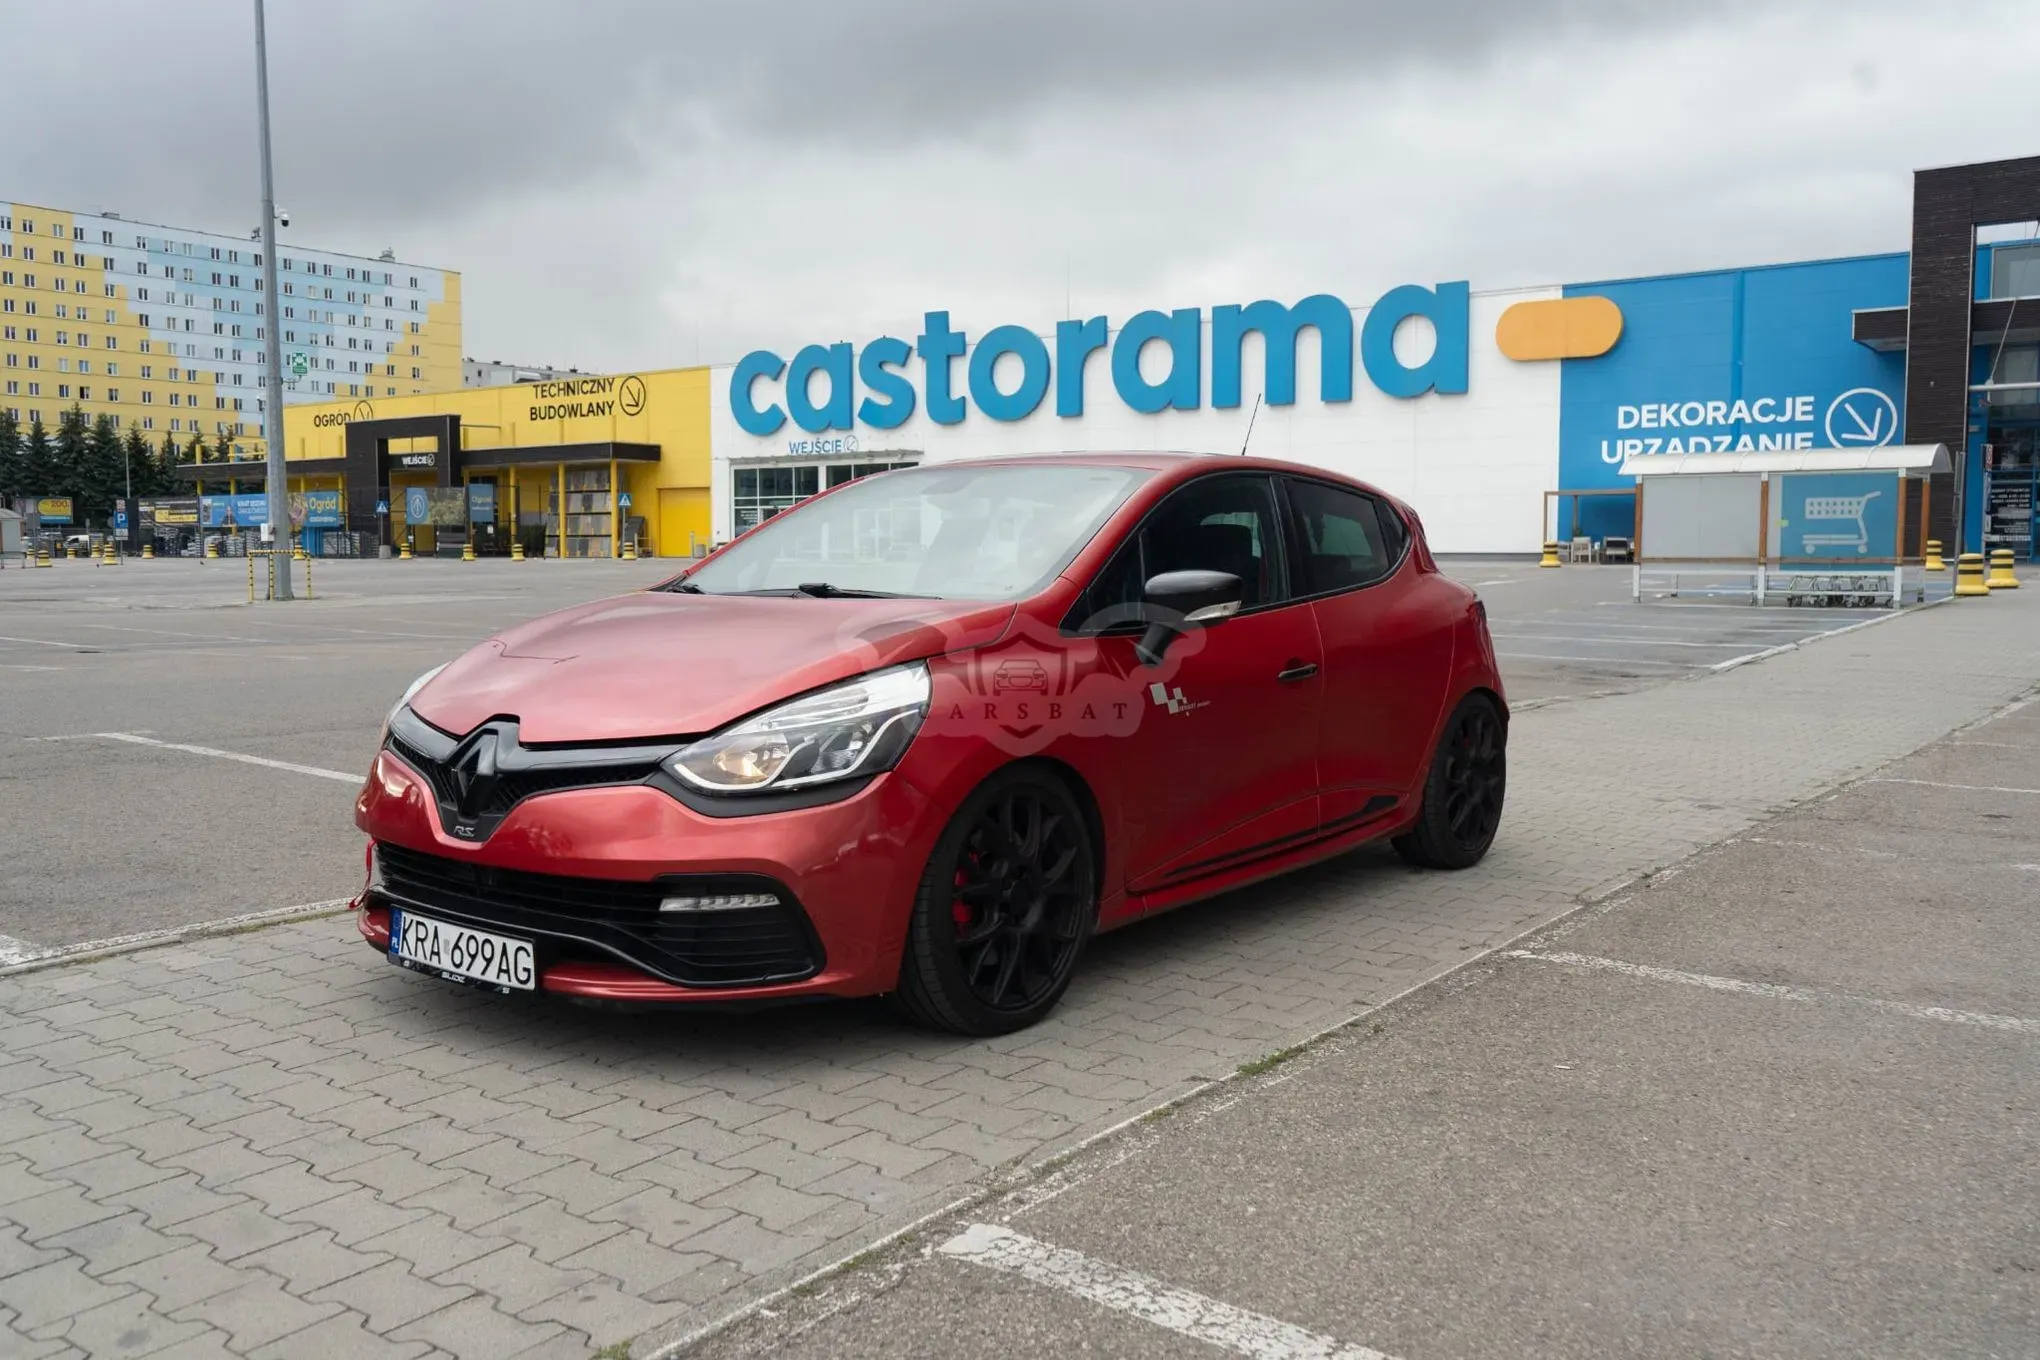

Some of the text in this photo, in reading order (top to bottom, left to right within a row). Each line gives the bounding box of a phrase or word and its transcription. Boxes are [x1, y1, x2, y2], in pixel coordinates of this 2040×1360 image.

[730, 280, 1469, 436] castorama
[532, 377, 616, 399] TECHNICZNY
[529, 400, 615, 421] BUDOWLANY
[1617, 396, 1815, 429] DEKORACJE
[788, 437, 842, 454] WEJŚCIE
[309, 496, 336, 514] Ogród
[400, 916, 532, 985] KRA 699AG
